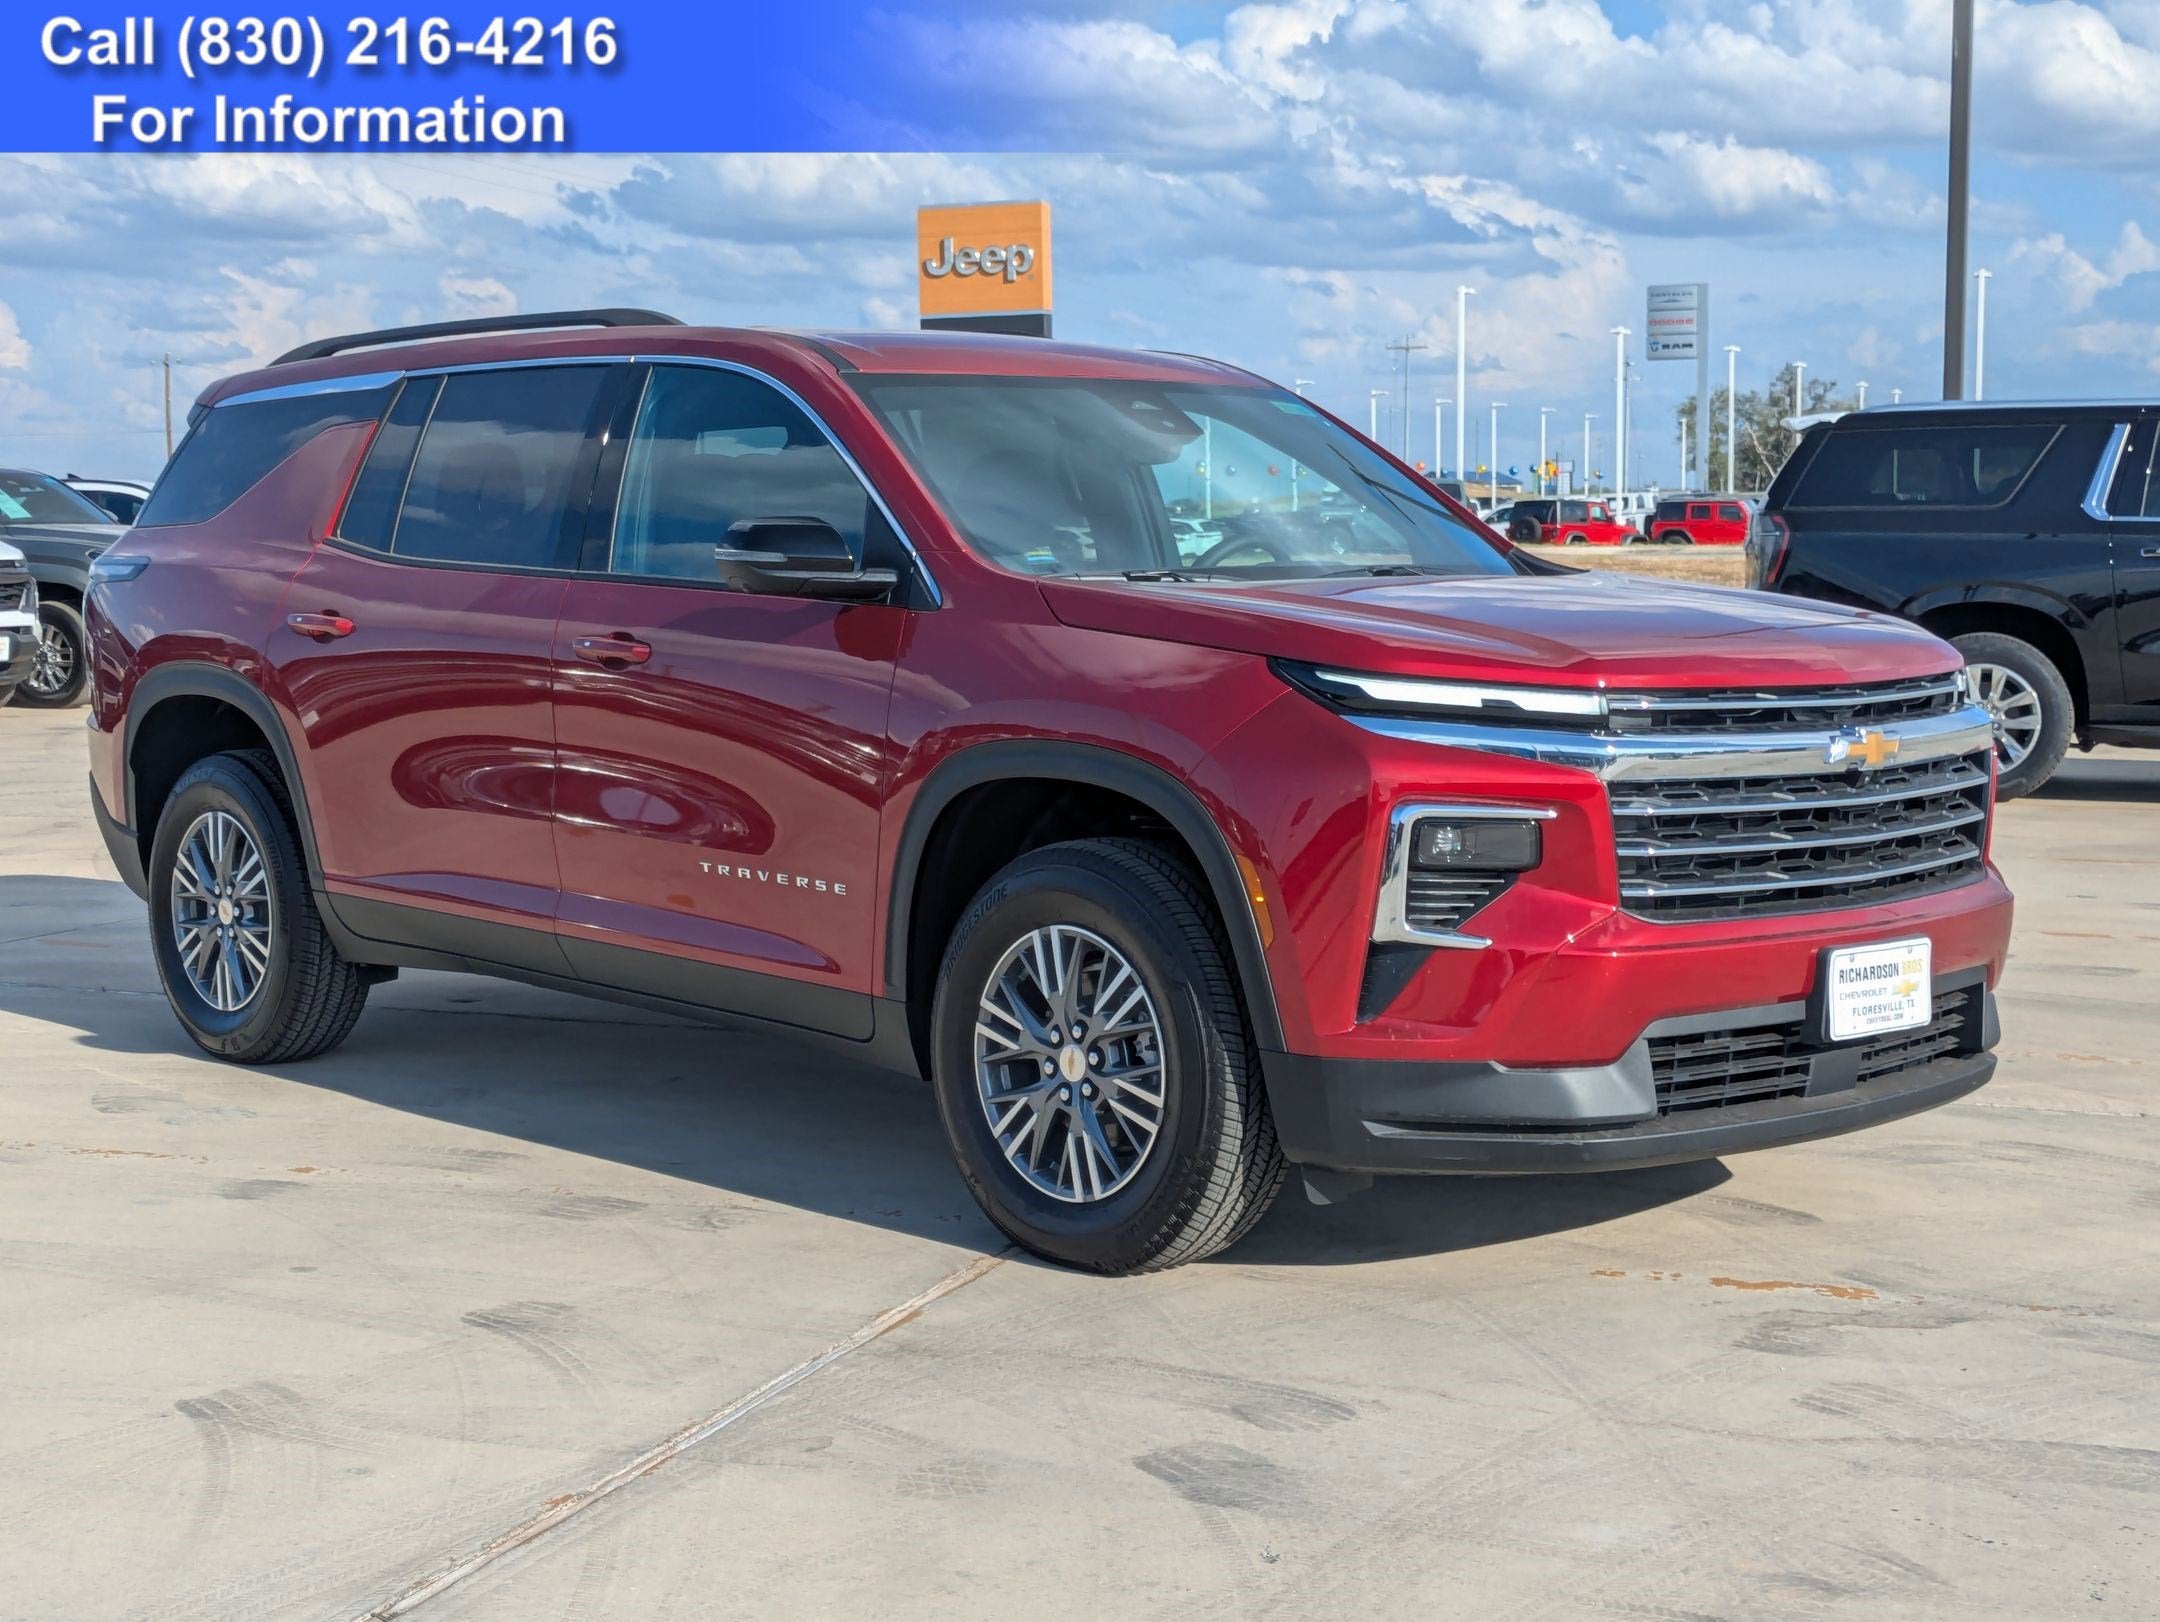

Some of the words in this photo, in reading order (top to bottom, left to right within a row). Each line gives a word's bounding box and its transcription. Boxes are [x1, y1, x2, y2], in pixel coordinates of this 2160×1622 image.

[923, 236, 1034, 284] Jeep
[699, 861, 847, 896] TRAVERSE
[1839, 962, 1899, 984] RICHARDSON
[1902, 959, 1922, 975] BROS
[1839, 987, 1888, 1001] CHEVROLET
[1907, 999, 1914, 1008] TX
